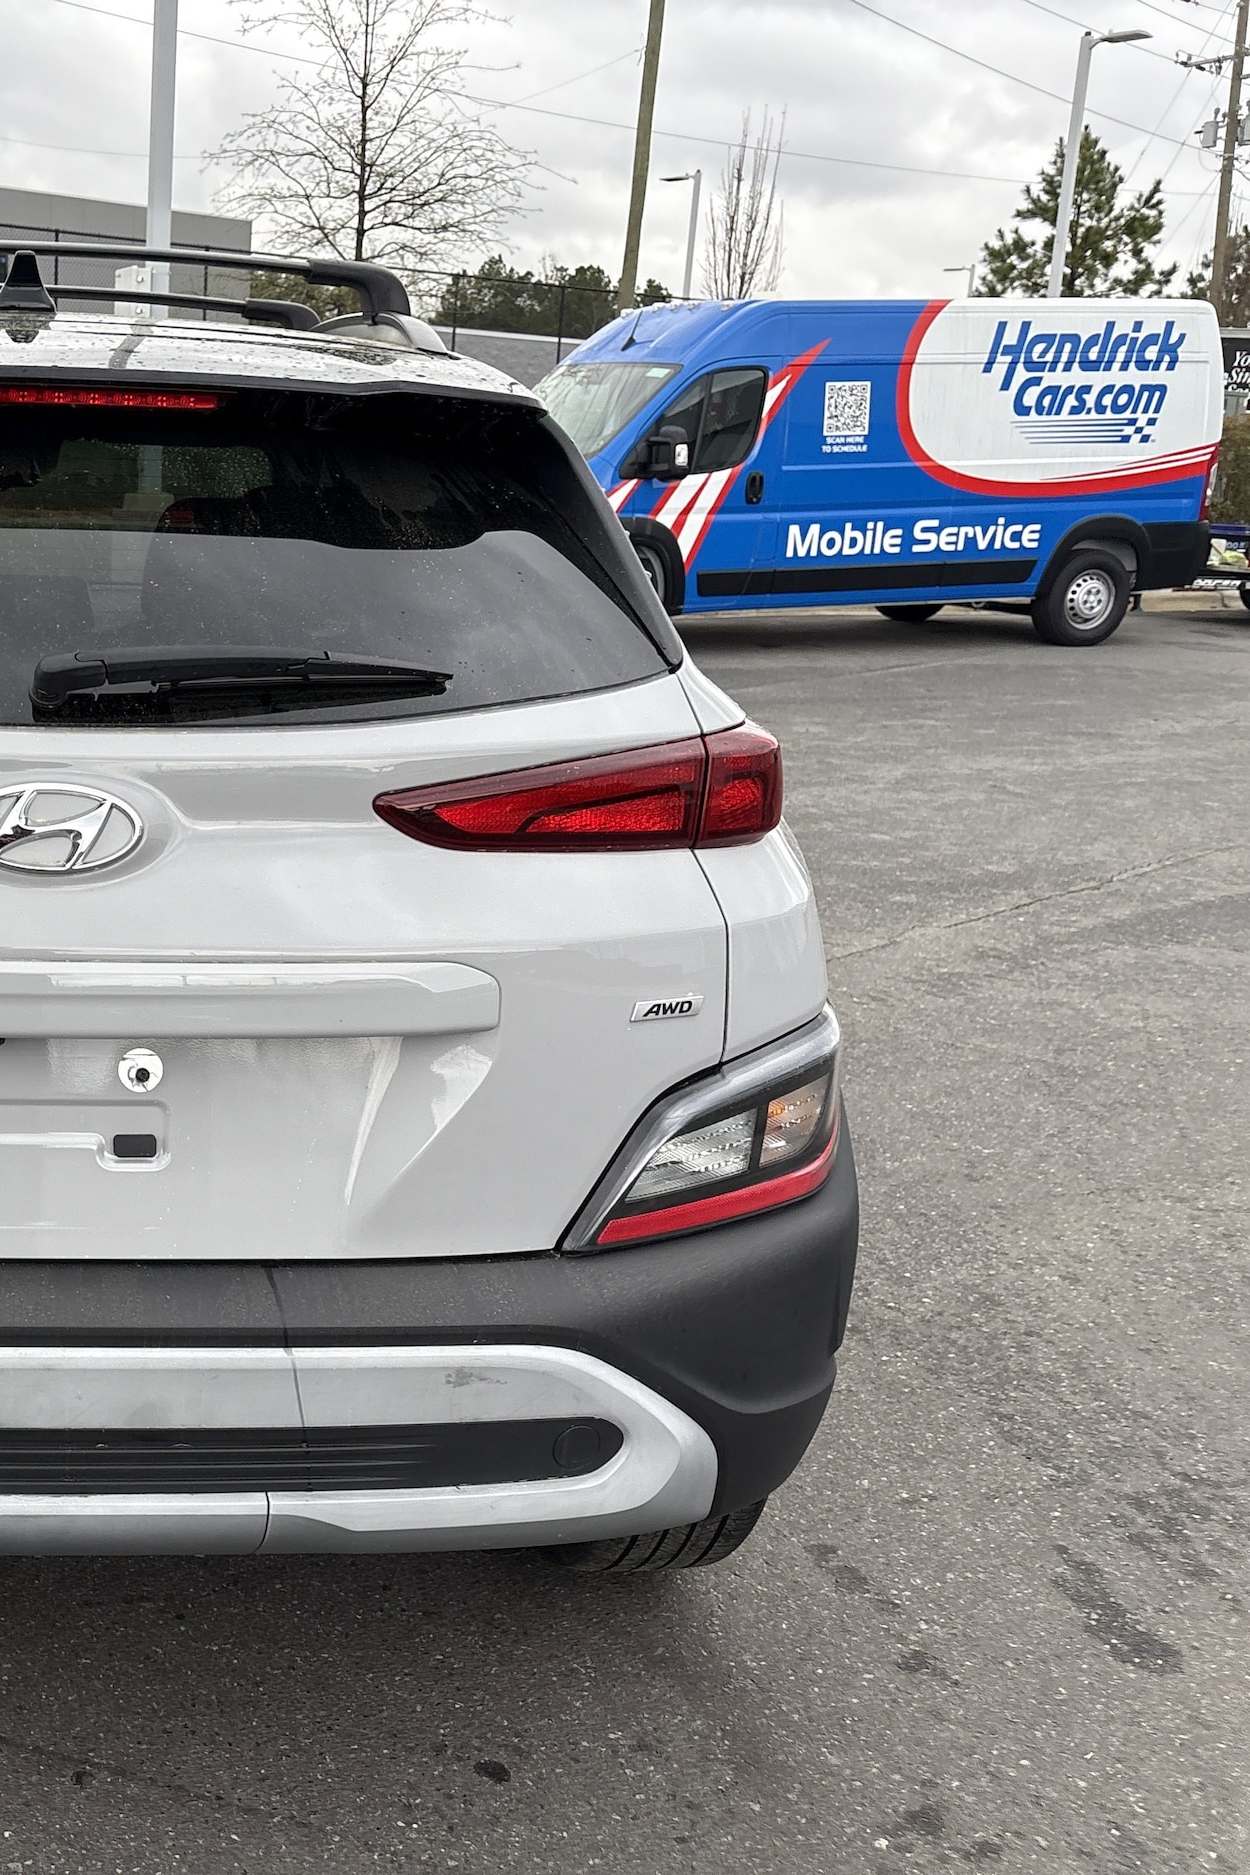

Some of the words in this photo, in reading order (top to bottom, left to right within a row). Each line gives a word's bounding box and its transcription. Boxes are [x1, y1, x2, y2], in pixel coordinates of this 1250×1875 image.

[981, 320, 1187, 391] Hendrick
[1013, 376, 1168, 416] Cars.com
[822, 445, 831, 453] TO
[826, 436, 845, 444] SCAN
[785, 521, 903, 558] Mobile
[912, 517, 1042, 553] Service
[642, 1000, 693, 1018] AWD
